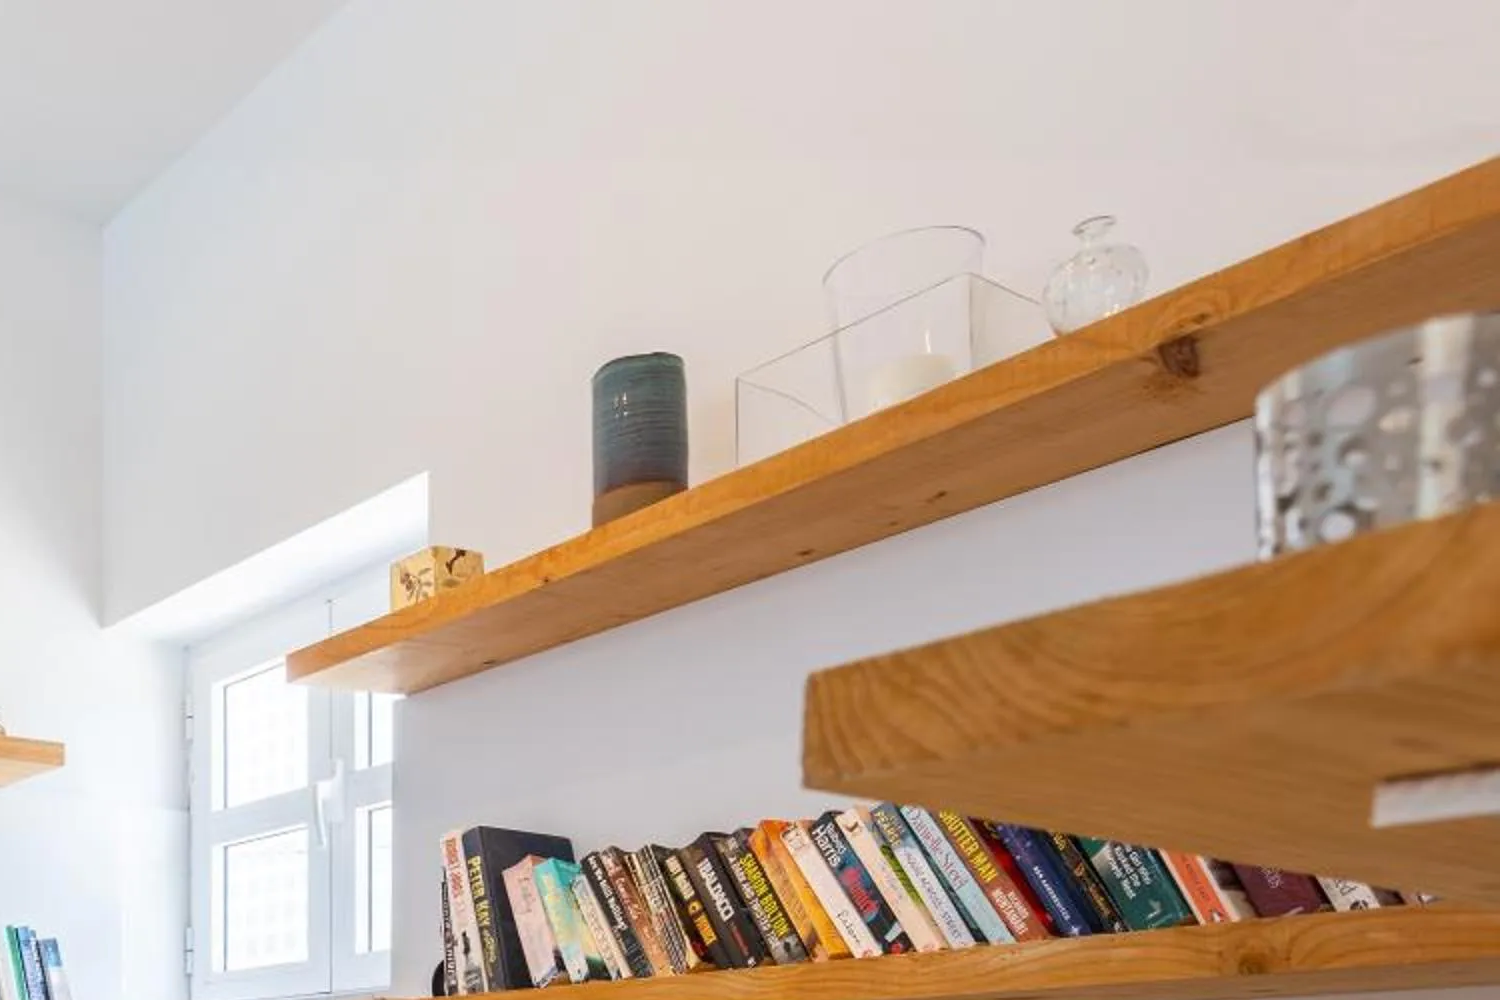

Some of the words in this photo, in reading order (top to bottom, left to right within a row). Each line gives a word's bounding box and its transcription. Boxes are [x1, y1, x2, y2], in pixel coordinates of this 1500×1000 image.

[812, 824, 841, 867] Harris
[909, 808, 944, 854] Danielle
[942, 852, 969, 890] Steel
[467, 855, 485, 897] PETER
[971, 852, 997, 884] MAN
